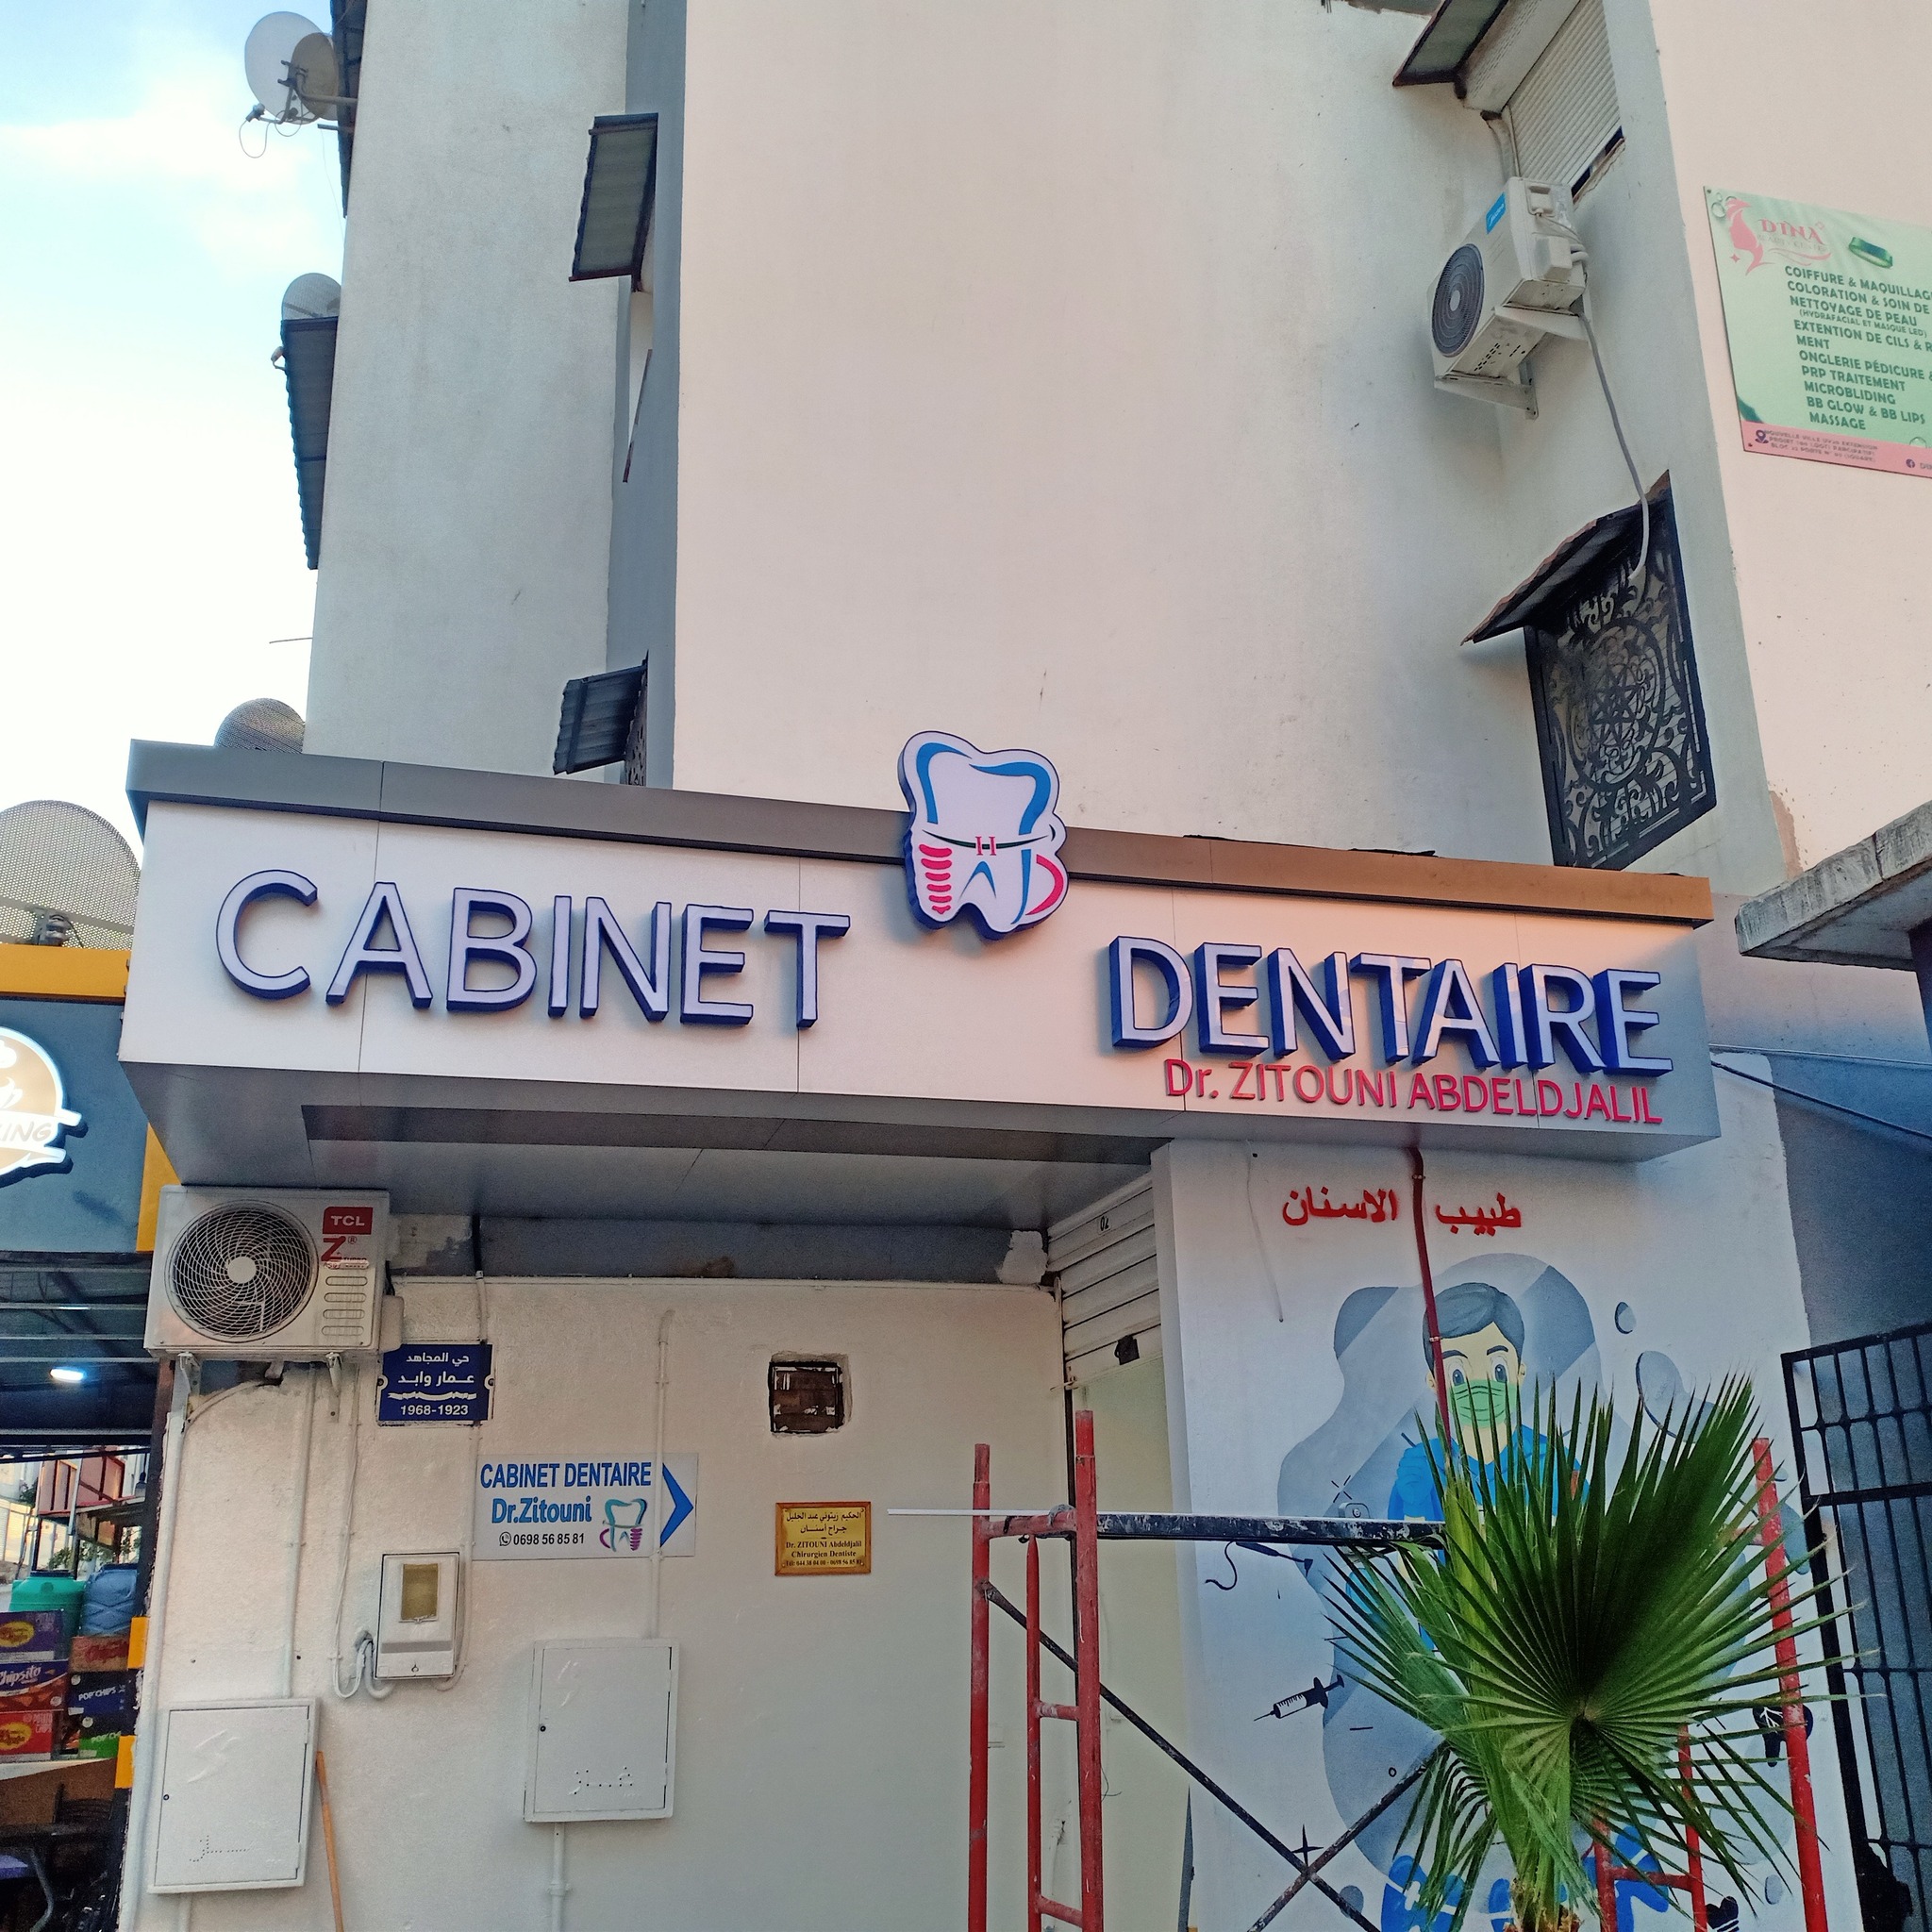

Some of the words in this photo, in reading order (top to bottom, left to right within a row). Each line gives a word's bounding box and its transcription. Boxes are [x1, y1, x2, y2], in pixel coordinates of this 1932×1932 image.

[1758, 218, 1825, 245] DINA
[1785, 265, 1844, 285] COIFFURE
[1849, 277, 1857, 288] &
[1859, 279, 1932, 300] MAQUILLAG
[1788, 280, 1867, 303] COLORATION
[1872, 295, 1879, 306] &
[1883, 297, 1911, 312] SOIN
[1914, 303, 1930, 314] DE
[1790, 295, 1863, 317] NETTOYAGE
[1866, 308, 1882, 321] DE
[1886, 312, 1917, 326] PEAU
[1794, 319, 1862, 340] EXTENTION
[1866, 331, 1882, 343] DE
[1886, 335, 1909, 348] CILS
[1913, 341, 1922, 350] &
[1874, 322, 1906, 334] MASQUE
[1796, 335, 1830, 350] MENT
[1799, 350, 1861, 370] ONGLERIE
[1864, 359, 1925, 380] PÉDICURE
[1802, 365, 1825, 378] PRP
[1829, 370, 1906, 391] TRAITEMENT
[1804, 380, 1896, 405] MICROBLIDING
[1807, 396, 1824, 408] BB
[1827, 399, 1864, 414] GLOW
[1869, 406, 1877, 417] &
[1881, 408, 1897, 420] BB
[1900, 410, 1925, 425] LIPS
[1809, 411, 1866, 430] MASSAGE
[216, 869, 851, 1030] CABINET
[1109, 935, 1674, 1077] DENTAIRE
[1164, 1058, 1219, 1099] Dr.
[1228, 1061, 1398, 1108] ZITOUNI
[1408, 1073, 1663, 1124] ABDELDJALIL
[1282, 1186, 1398, 1226] الاسنان
[1436, 1192, 1522, 1237] طبيب
[330, 1215, 365, 1226] TCL
[406, 1352, 449, 1365] المجاهد
[452, 1355, 470, 1367] حي
[436, 1371, 475, 1387] عمار
[401, 1405, 469, 1416] 1968-1923
[480, 1463, 560, 1489] CABINET
[564, 1462, 652, 1488] DENTAIRE
[491, 1495, 592, 1524] Dr.Zitouni
[808, 1513, 818, 1522] عبد
[513, 1534, 540, 1546] 0698
[541, 1533, 555, 1545] 56
[557, 1533, 571, 1545] 85
[572, 1533, 585, 1544] 81
[828, 1524, 847, 1536] جراح
